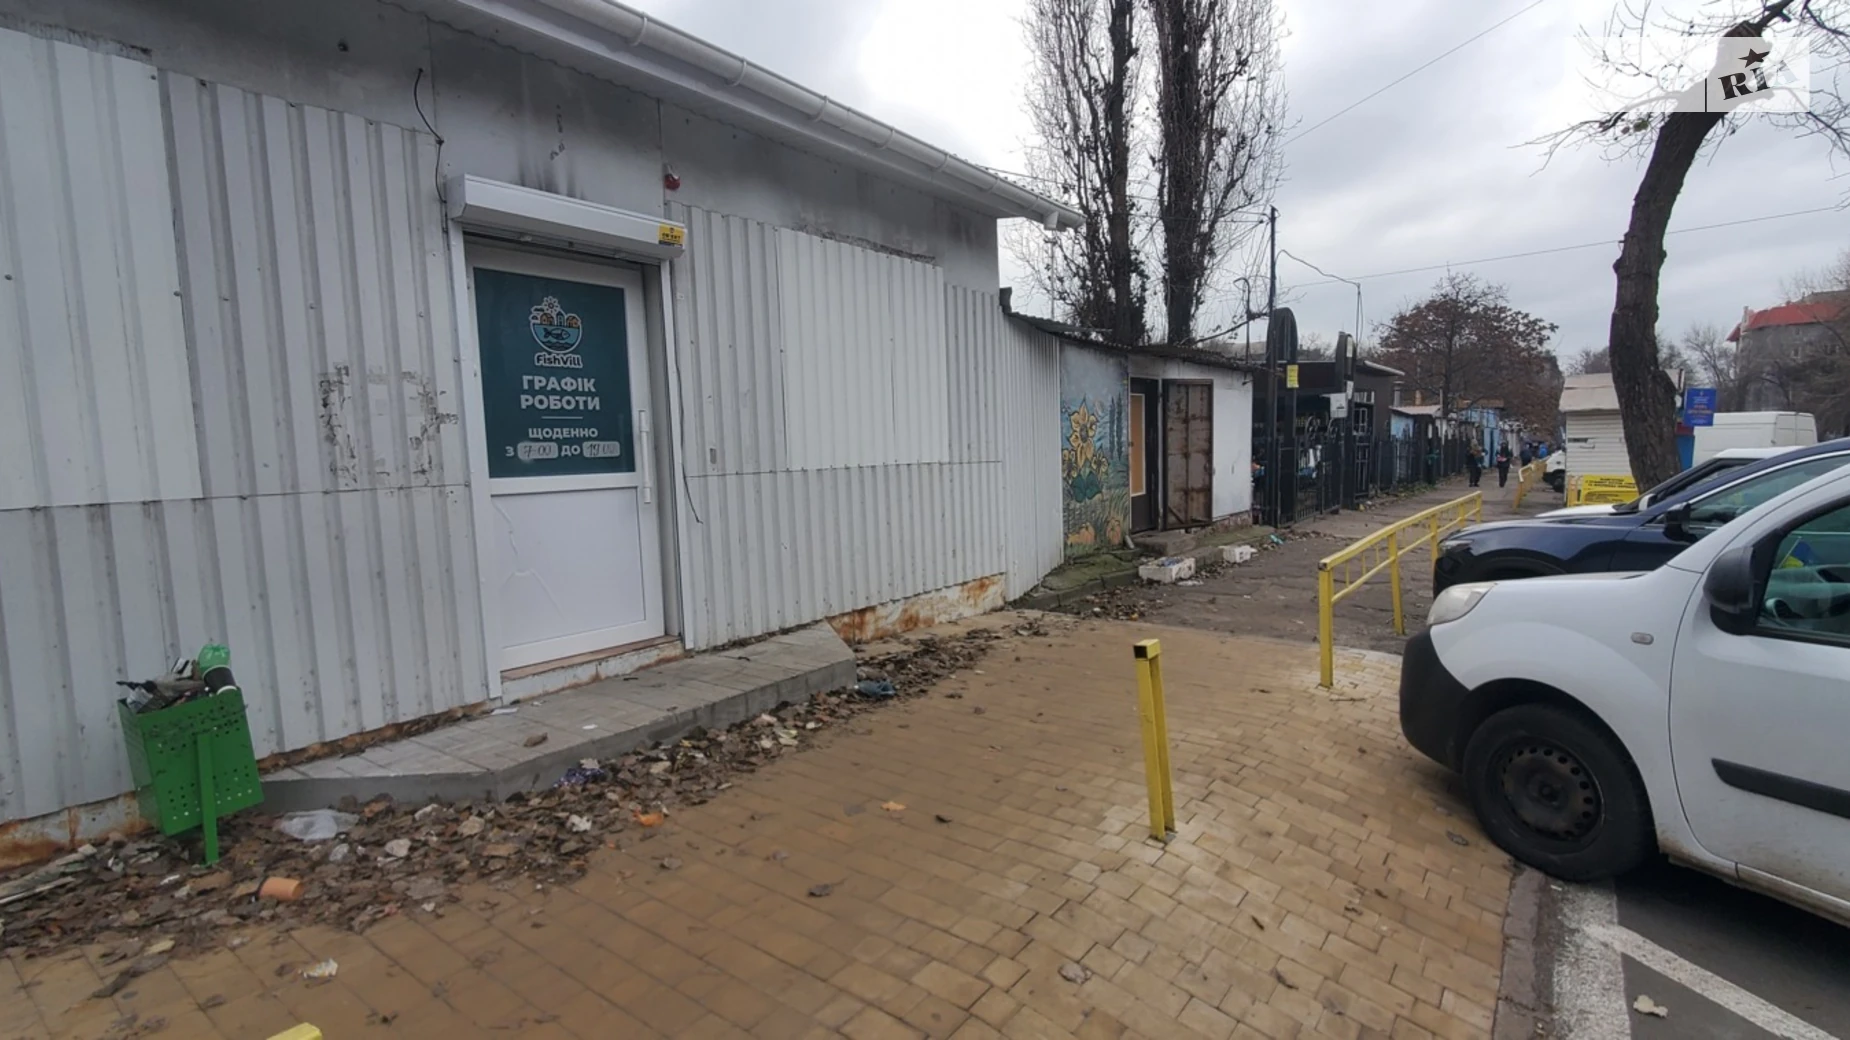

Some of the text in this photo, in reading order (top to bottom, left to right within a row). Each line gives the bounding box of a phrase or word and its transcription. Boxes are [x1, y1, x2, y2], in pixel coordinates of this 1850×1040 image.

[536, 353, 582, 368] FishVill
[522, 375, 596, 392] ГРАФІК
[520, 395, 600, 410] РОБОТИ
[528, 428, 598, 439] ЩОДЕННО
